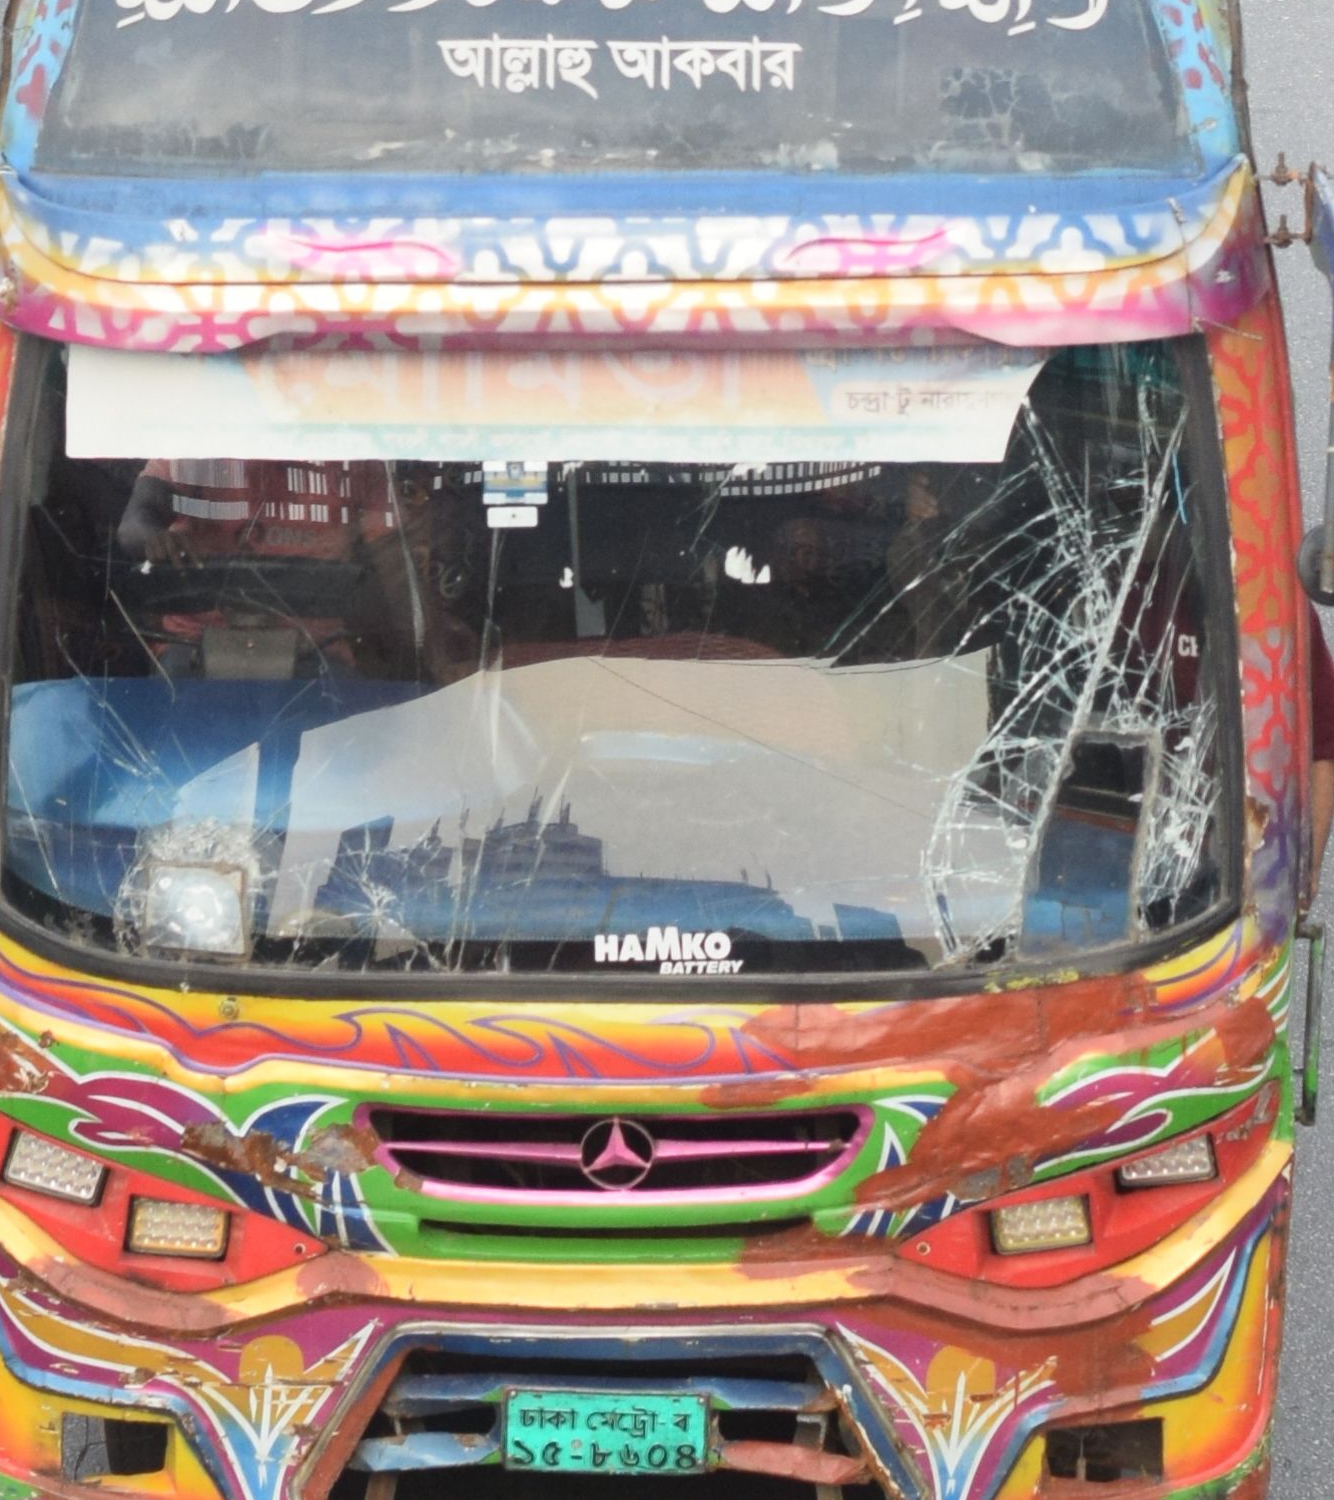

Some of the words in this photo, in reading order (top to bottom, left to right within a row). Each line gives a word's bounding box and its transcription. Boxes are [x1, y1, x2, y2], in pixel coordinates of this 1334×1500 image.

[436, 32, 599, 100] আল্লাহু
[605, 33, 804, 92] আকবার
[594, 926, 732, 962] HAMKO
[659, 959, 744, 975] BATTERY
[519, 1407, 578, 1430] ঢাকা
